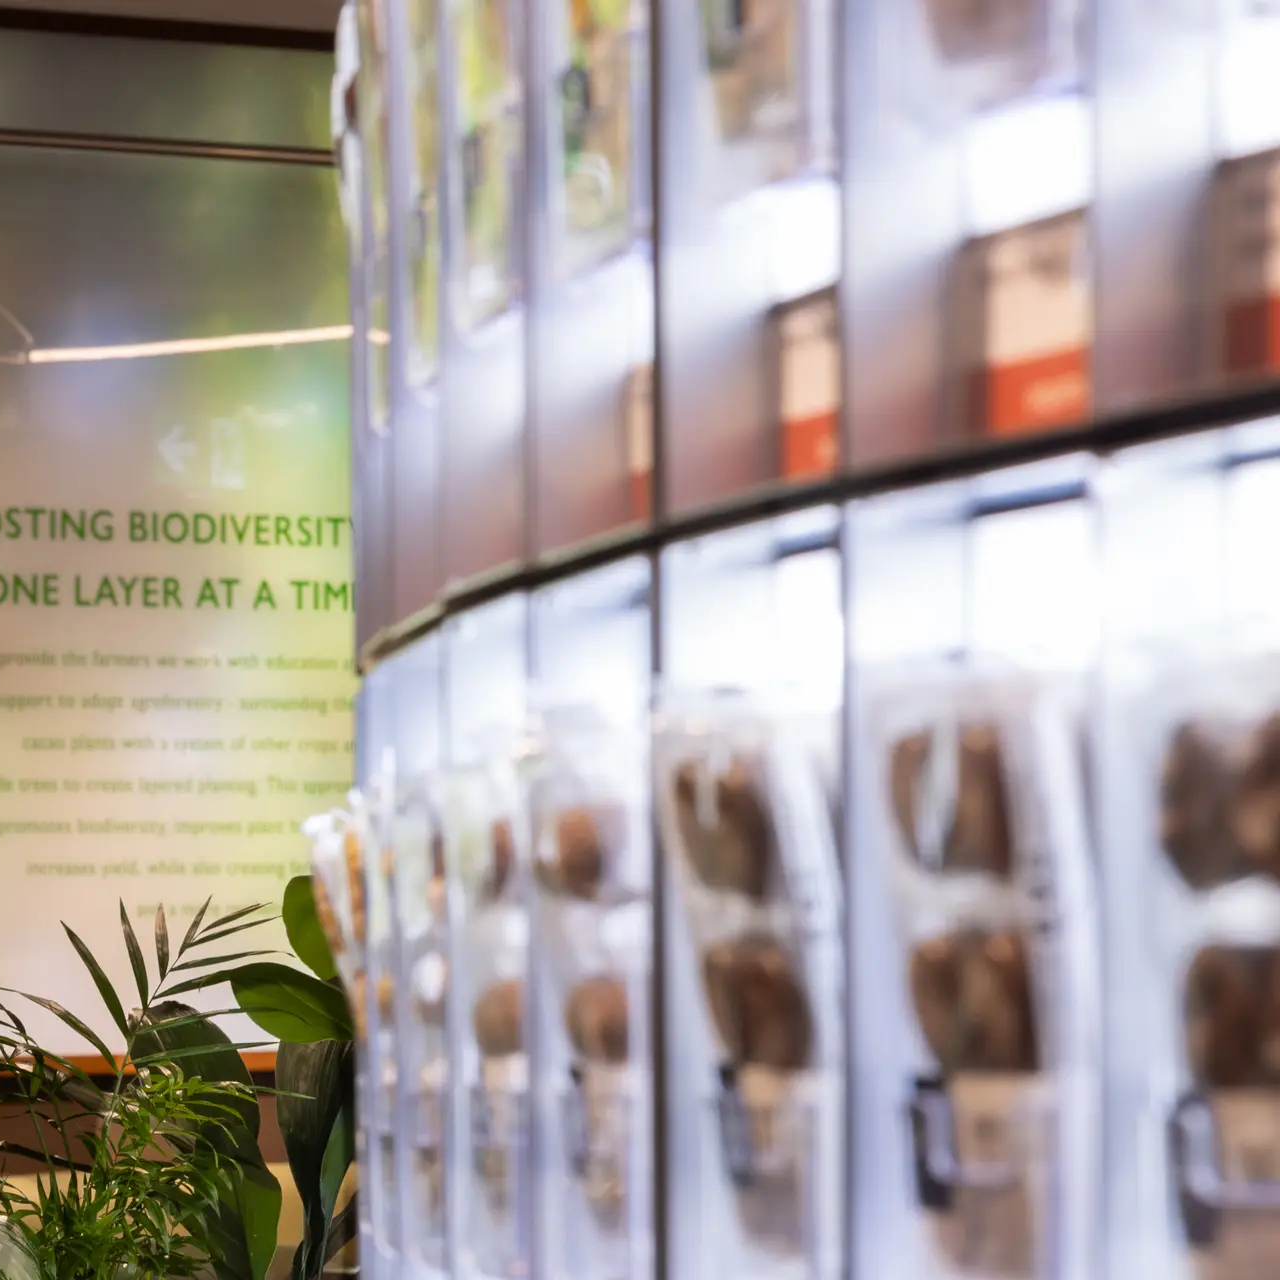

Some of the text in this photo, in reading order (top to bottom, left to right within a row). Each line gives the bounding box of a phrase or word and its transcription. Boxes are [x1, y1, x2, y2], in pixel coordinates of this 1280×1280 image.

[74, 574, 182, 609] LAYER
[196, 578, 240, 610] AT
[253, 579, 277, 610] A
[61, 650, 86, 667] the
[92, 650, 151, 668] farmers
[183, 653, 221, 667] work
[227, 652, 260, 669] with
[266, 654, 338, 670] education
[58, 695, 75, 709] to
[81, 692, 124, 712] adopt
[70, 735, 116, 754] plants
[121, 736, 155, 751] with
[174, 739, 224, 754] system
[250, 737, 290, 752] other
[17, 778, 58, 793] trees
[63, 778, 81, 793] to
[85, 778, 133, 793] create
[138, 778, 192, 795] layered
